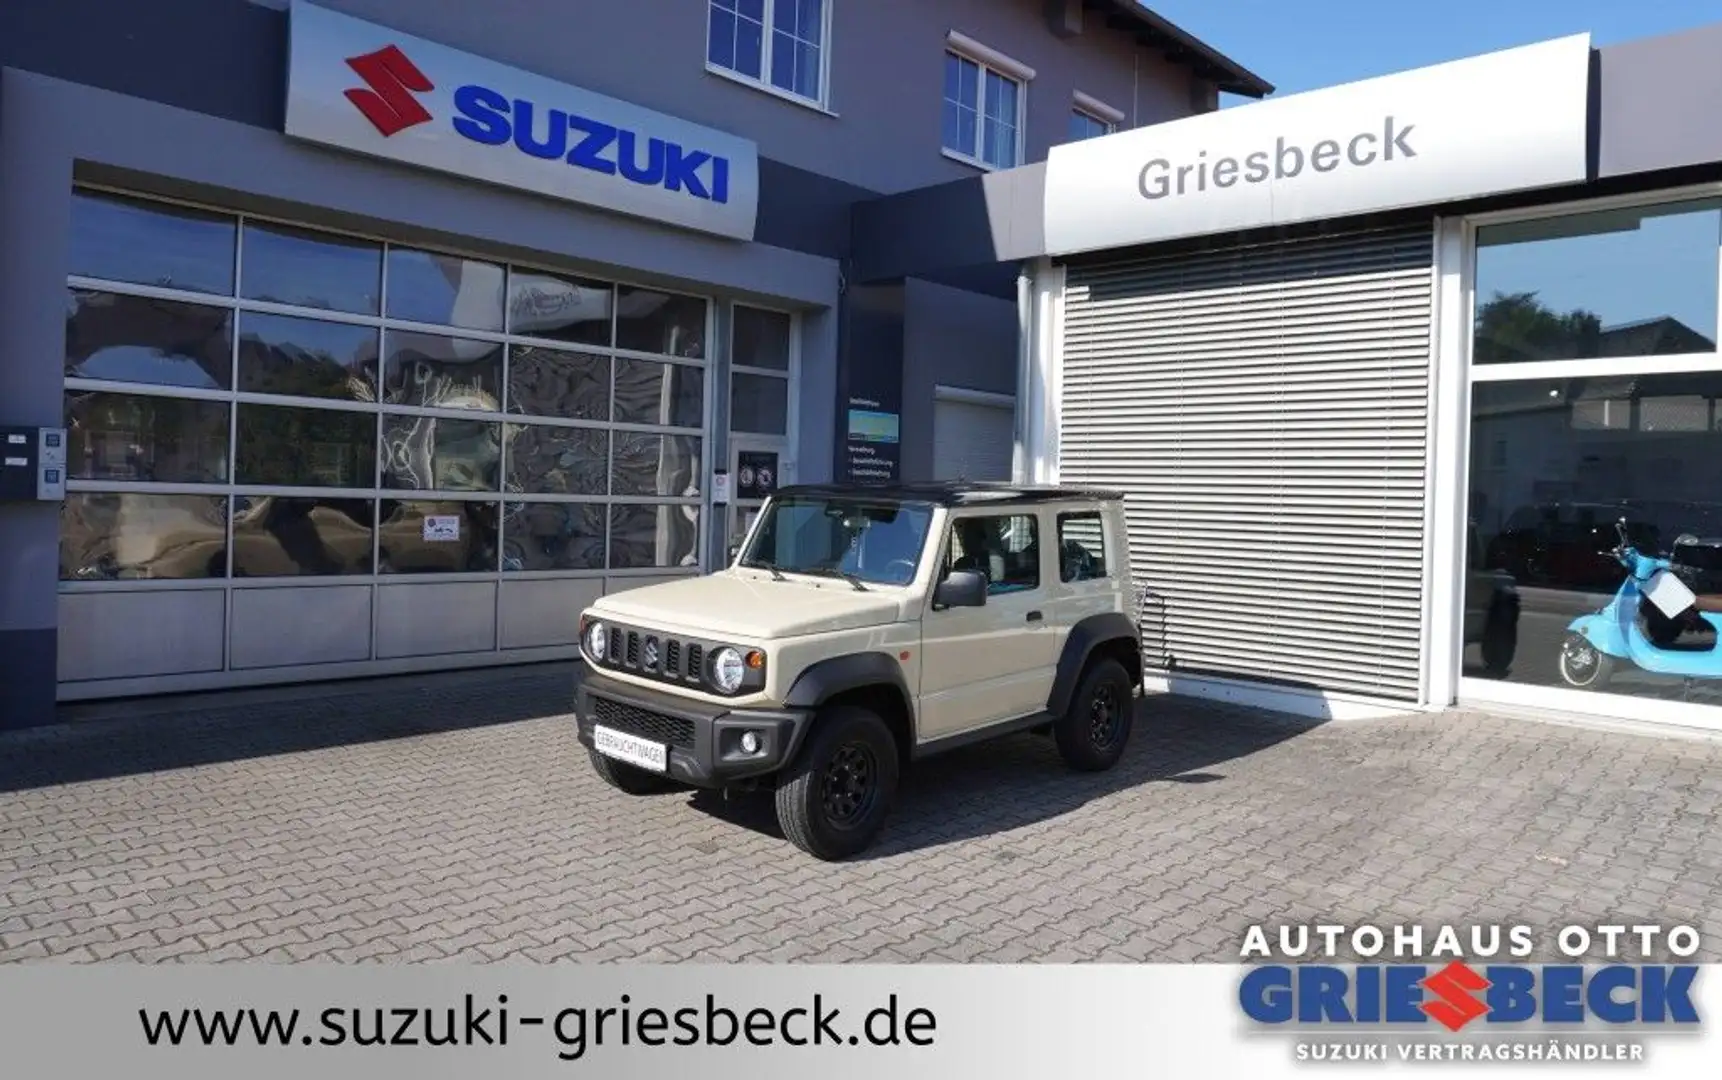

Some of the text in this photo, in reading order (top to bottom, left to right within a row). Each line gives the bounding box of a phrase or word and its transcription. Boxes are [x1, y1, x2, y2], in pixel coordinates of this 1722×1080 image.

[452, 84, 728, 204] SUZUKI
[1138, 115, 1418, 200] Griesbeck
[596, 731, 665, 765] GEBRAUCHTWAGEN
